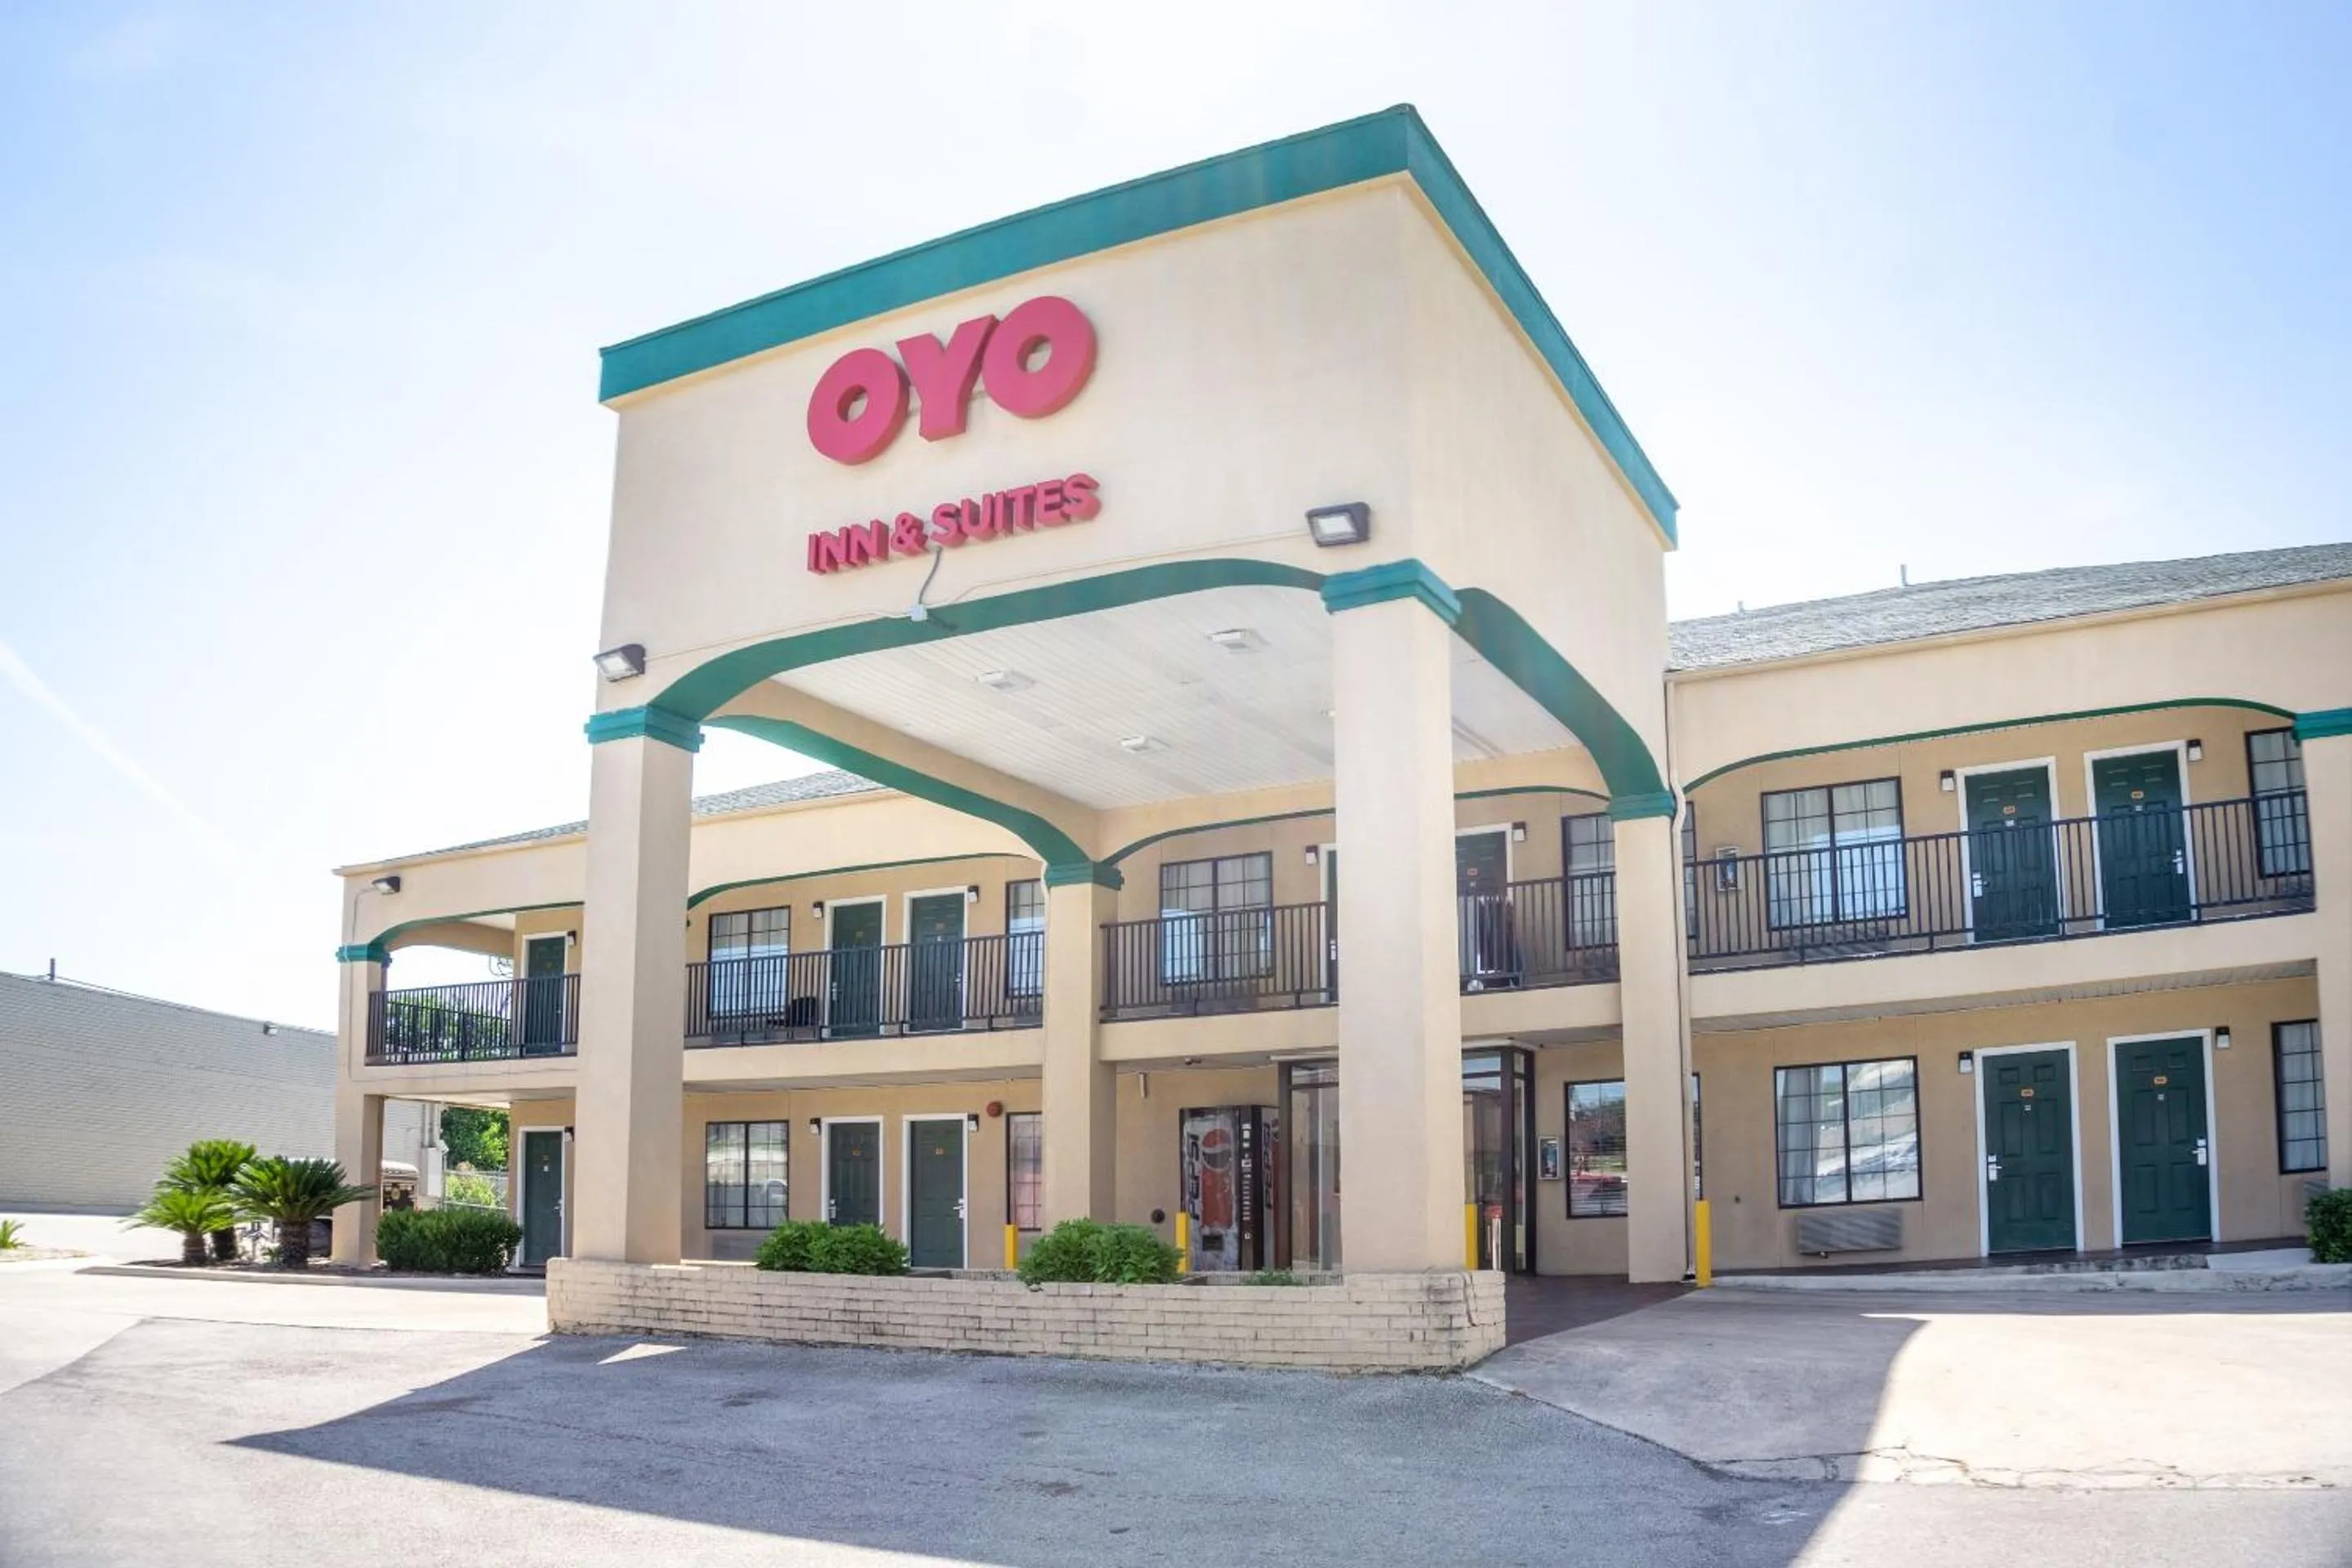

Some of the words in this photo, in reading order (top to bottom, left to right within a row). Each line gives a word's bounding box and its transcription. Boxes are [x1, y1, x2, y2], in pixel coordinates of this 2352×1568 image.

[807, 296, 1097, 466] OYO
[807, 519, 889, 575] INN
[891, 513, 928, 556] &
[931, 473, 1101, 548] SUITES
[1188, 1134, 1200, 1220] PEPSI
